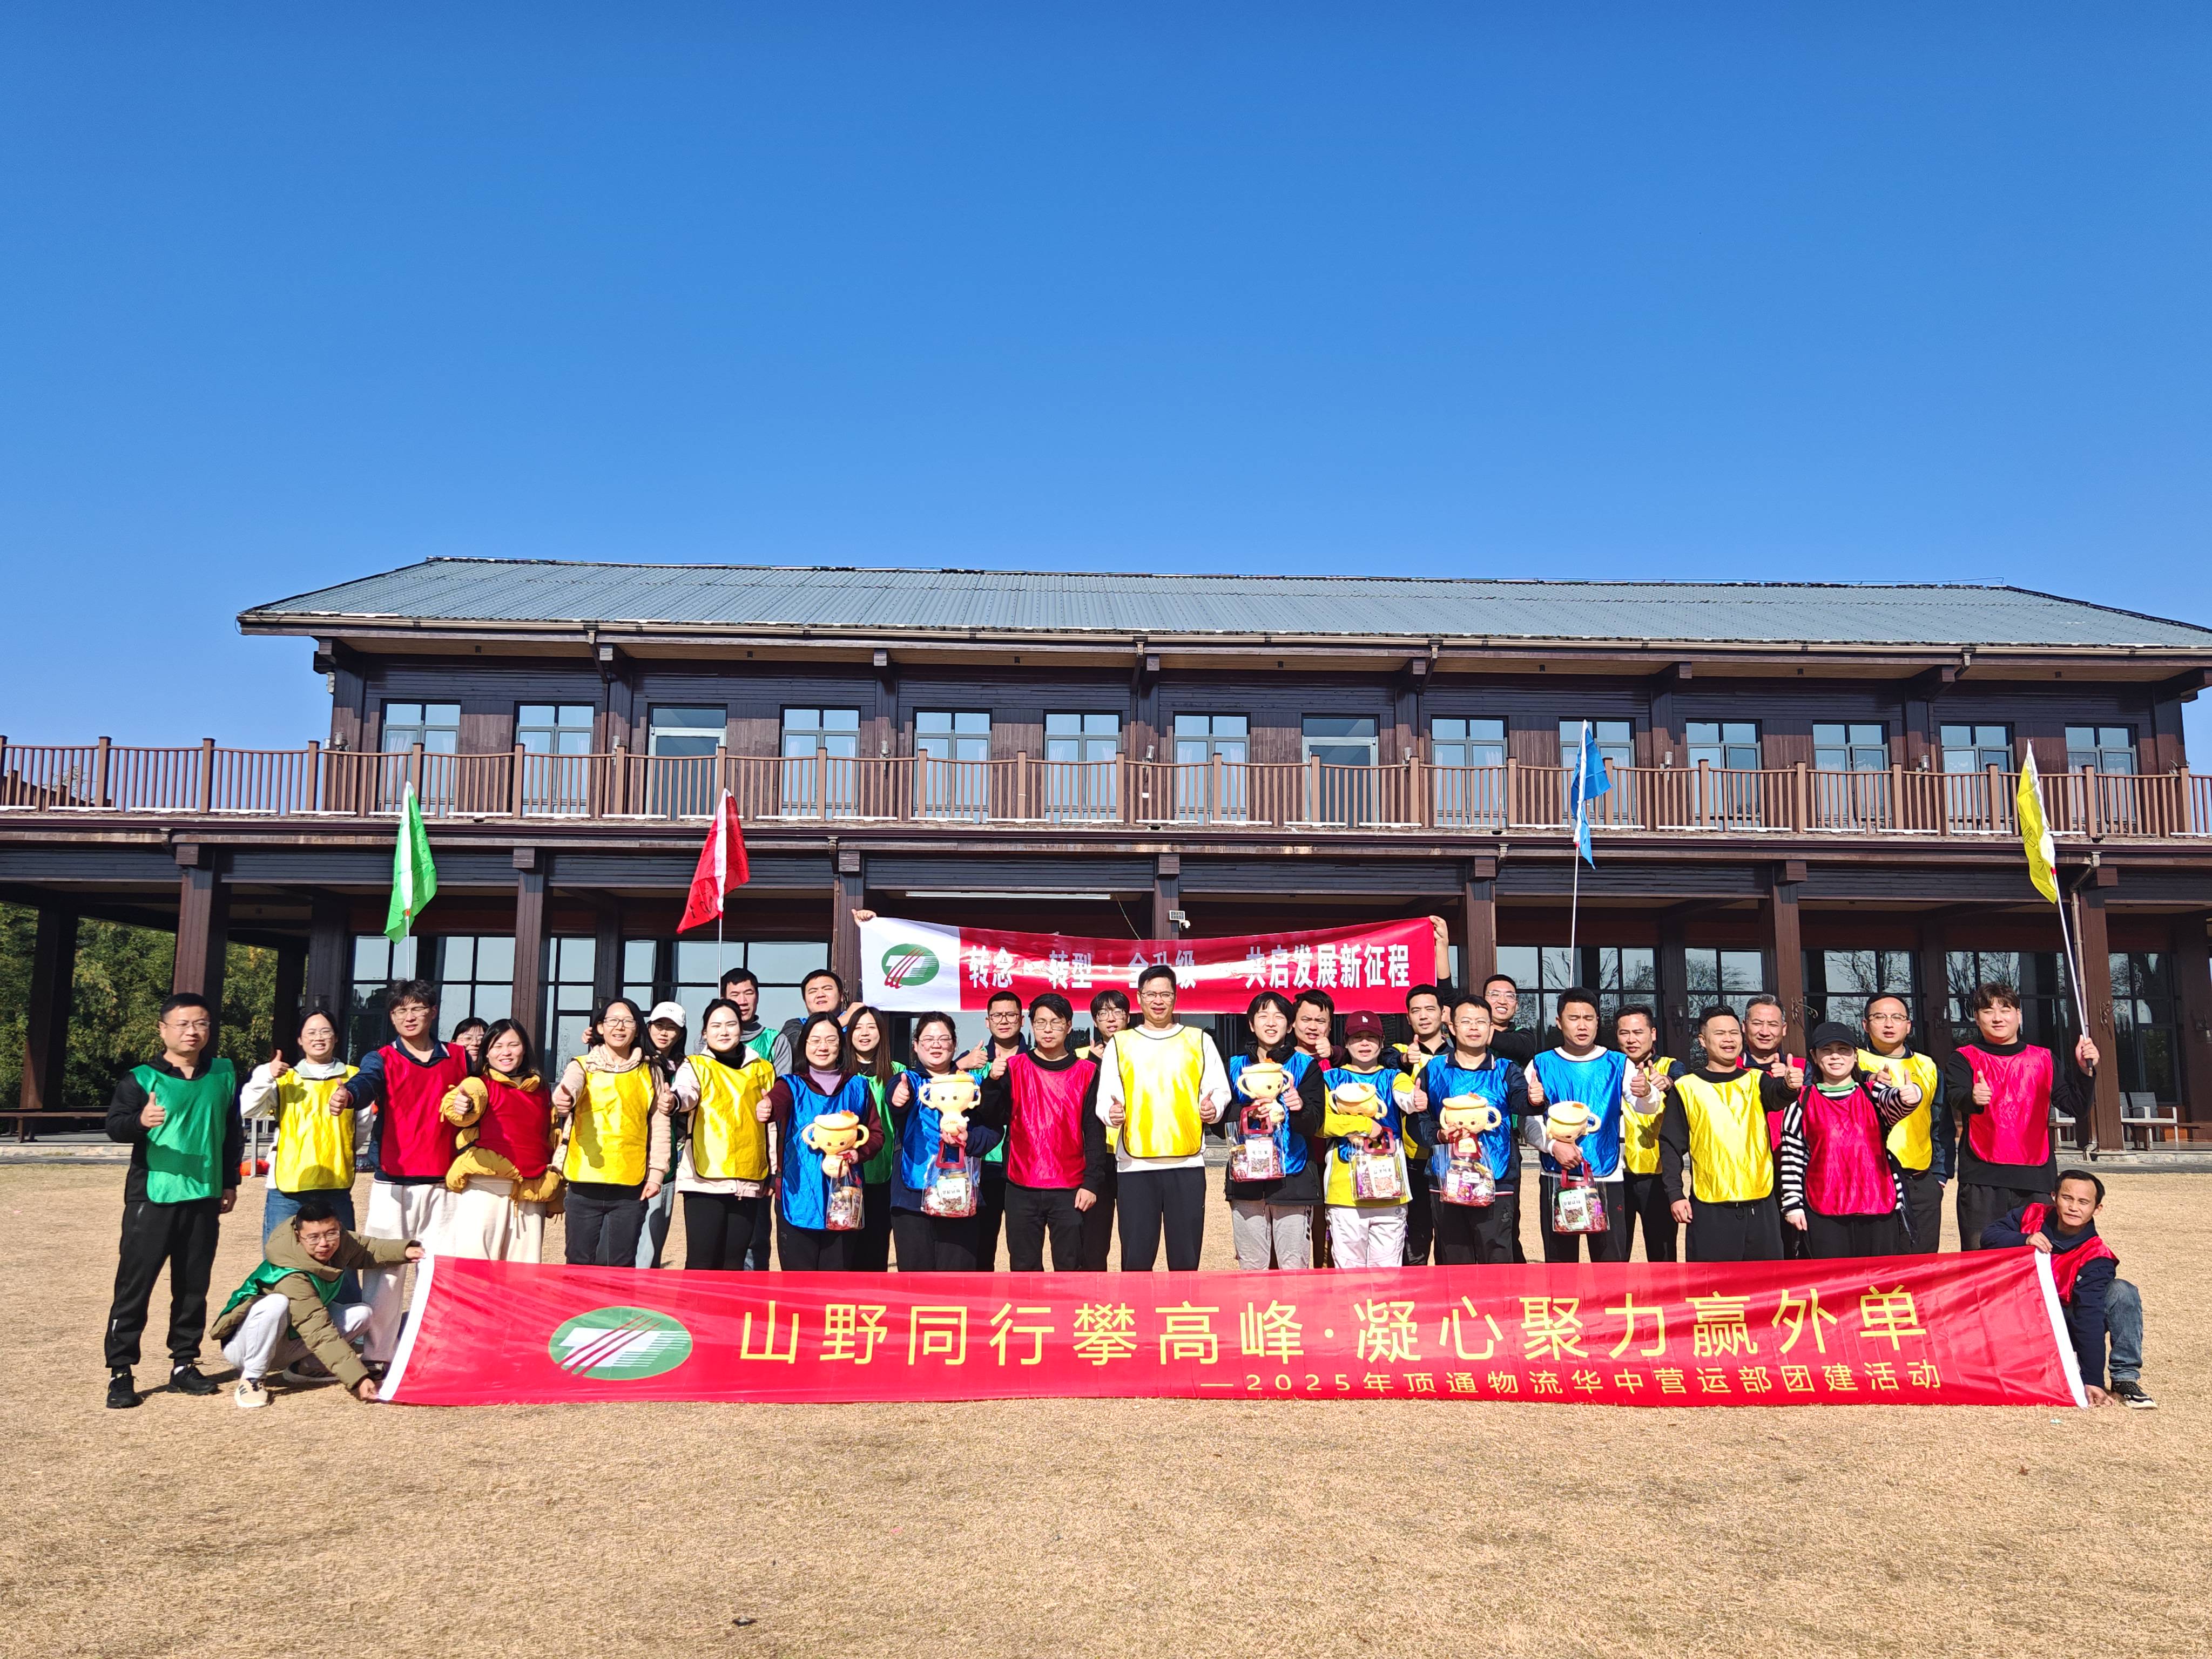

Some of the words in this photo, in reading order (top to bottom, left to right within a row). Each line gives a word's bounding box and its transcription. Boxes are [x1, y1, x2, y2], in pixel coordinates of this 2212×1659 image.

[1245, 943, 1411, 989] 共启发展新征程
[740, 1285, 1927, 1365] 山野同行攀高峰·凝心聚力赢外单
